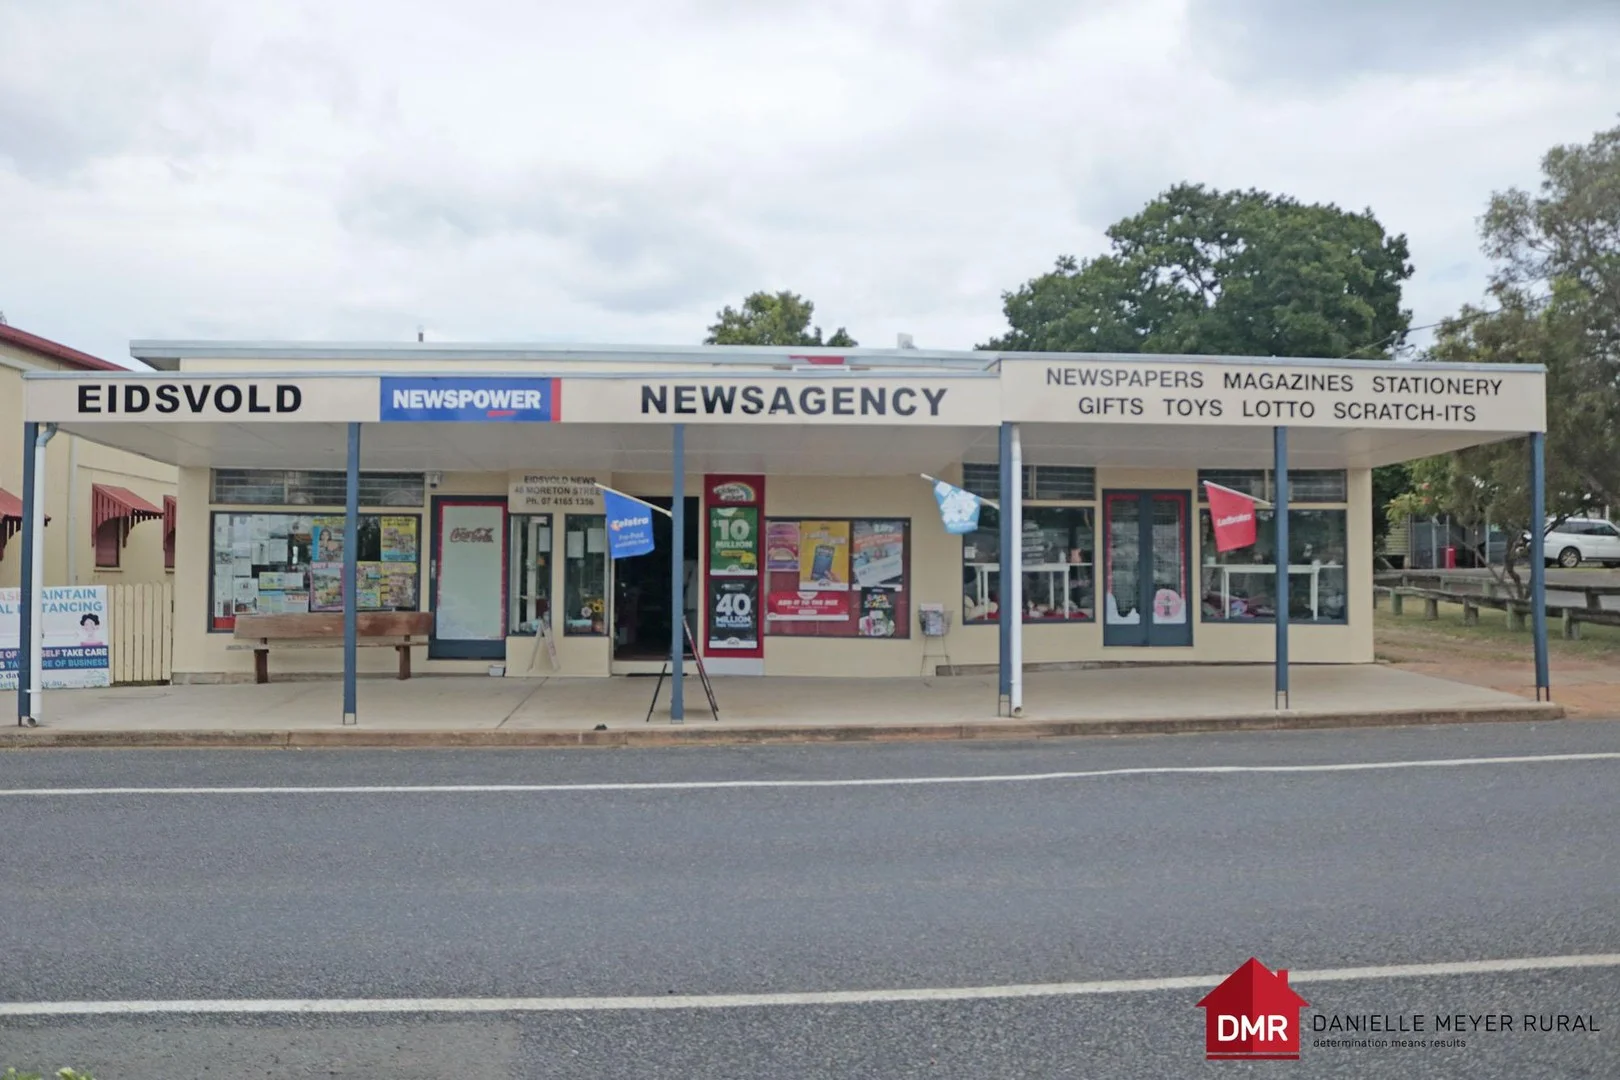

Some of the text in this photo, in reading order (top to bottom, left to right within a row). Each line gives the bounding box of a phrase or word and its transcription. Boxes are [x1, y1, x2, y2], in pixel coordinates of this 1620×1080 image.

[1048, 368, 1502, 396] NEWSPAPERS MAGAZINES STATIONERY
[78, 385, 302, 414] EIDSVOLD
[393, 389, 542, 410] NEWSPOWER
[641, 385, 947, 416] NEWSAGENCY
[1079, 396, 1476, 422] GIFTS TOYS LOTTO SCRATCH-ITS
[572, 487, 602, 496] STREE
[712, 519, 750, 540] $10
[715, 540, 753, 549] MILLION
[42, 588, 97, 599] AINTAIN
[715, 592, 752, 616] $40
[62, 649, 84, 657] TAKE
[85, 648, 108, 656] CARE
[67, 659, 107, 667] BUSINESS
